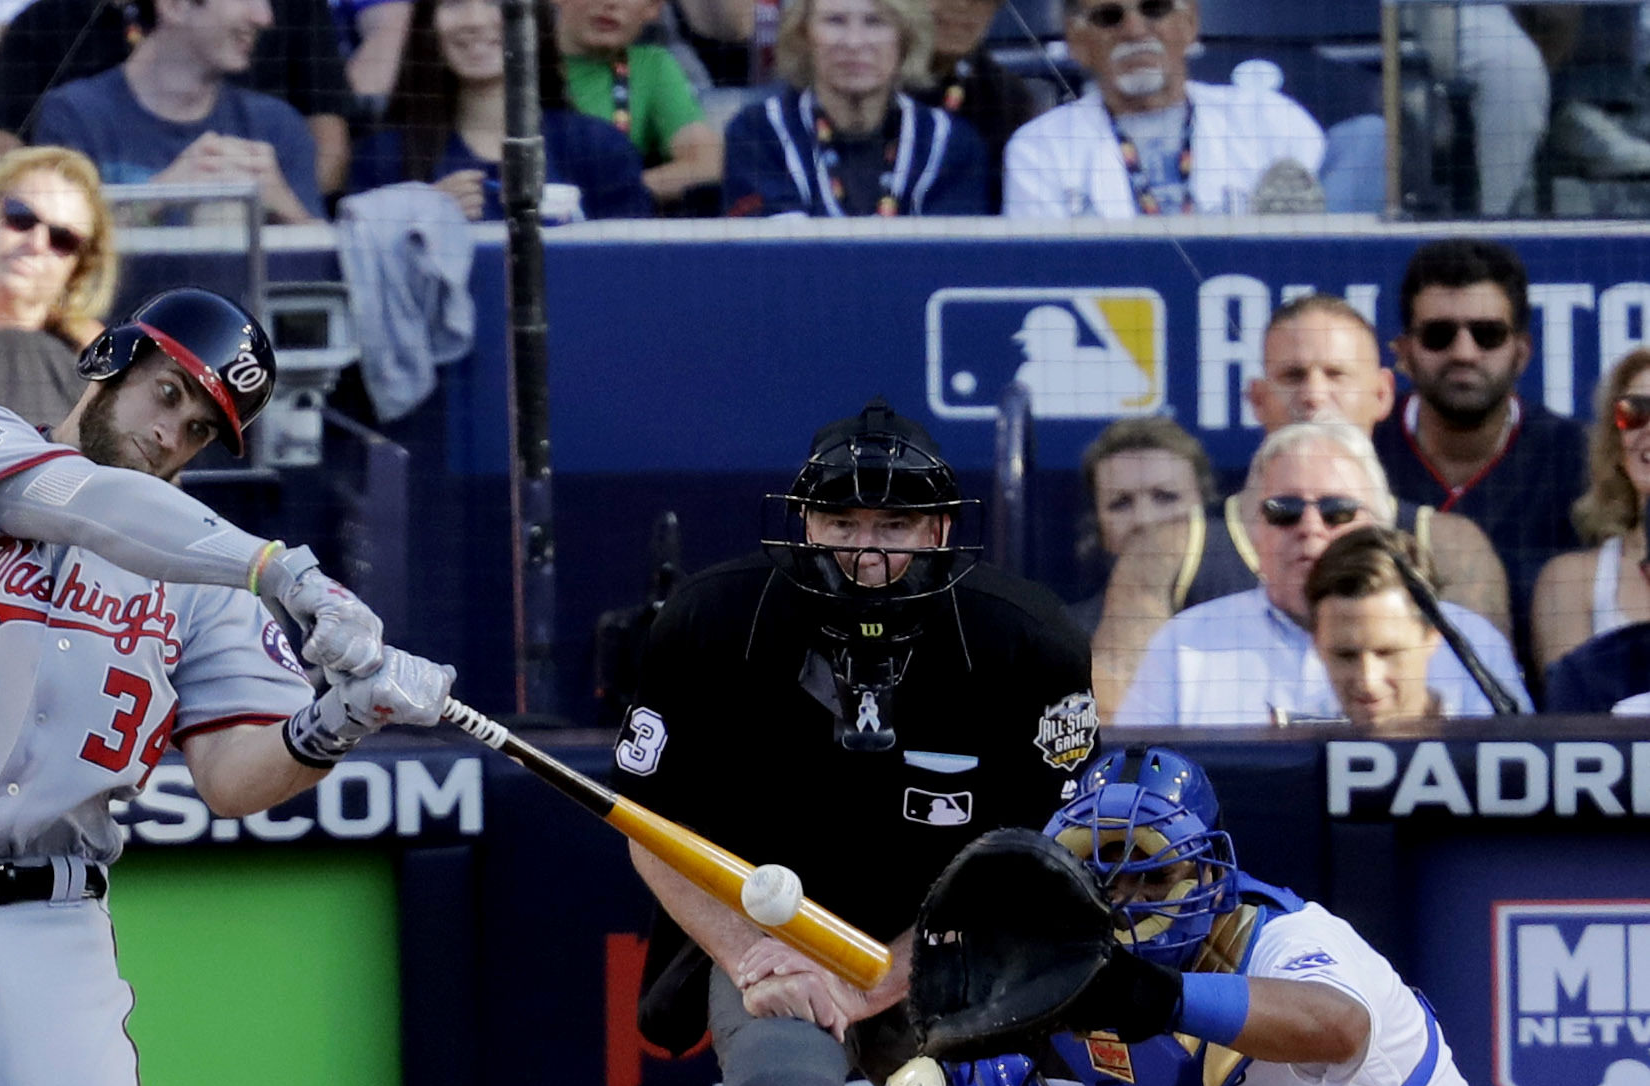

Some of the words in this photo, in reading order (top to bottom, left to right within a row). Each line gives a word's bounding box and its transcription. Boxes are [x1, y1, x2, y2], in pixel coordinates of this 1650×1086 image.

[227, 351, 267, 392] W
[616, 706, 669, 776] 3
[1055, 730, 1086, 753] GAME
